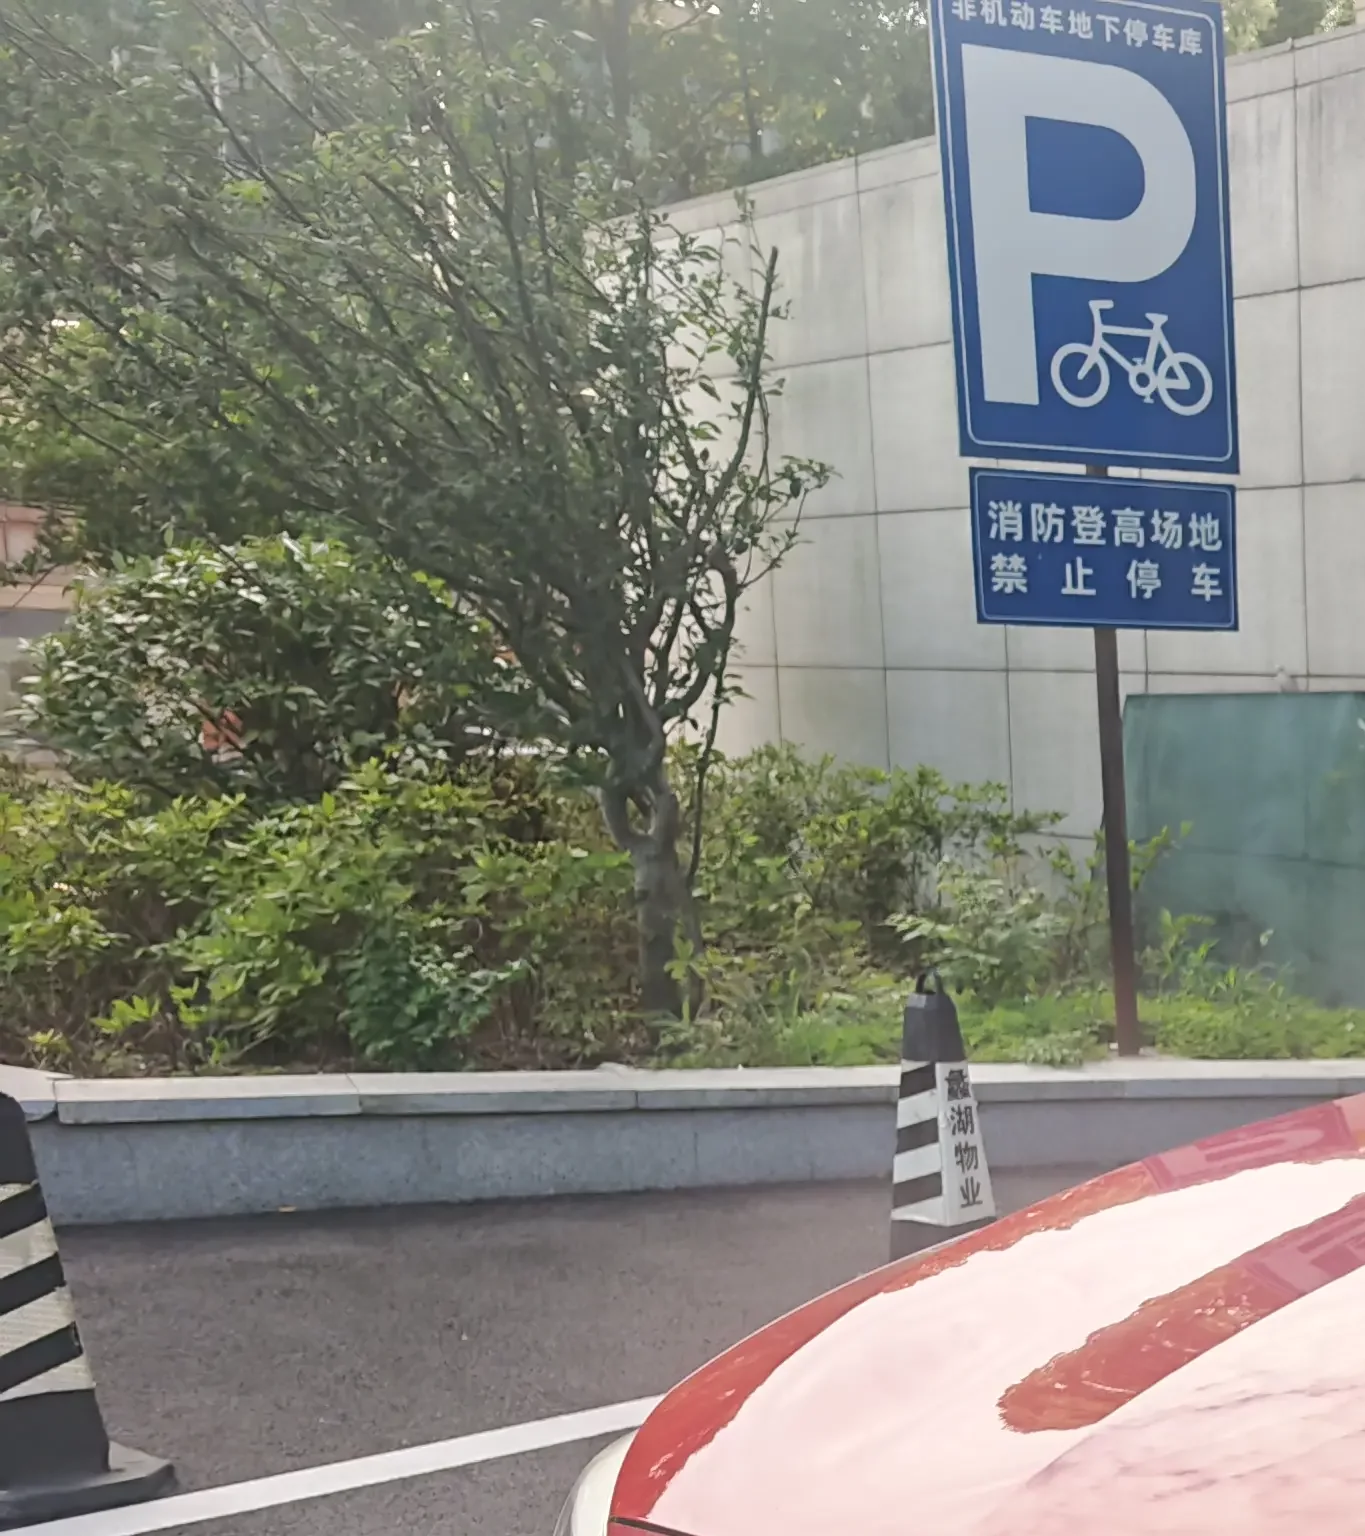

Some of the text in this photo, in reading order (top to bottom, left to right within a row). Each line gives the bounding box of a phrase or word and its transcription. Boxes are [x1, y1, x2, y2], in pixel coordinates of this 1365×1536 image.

[952, 0, 1202, 56] 非机动车地下停车库
[962, 44, 1197, 406] P
[988, 500, 1223, 551] 消防登高场地
[990, 553, 1223, 602] 禁止停车
